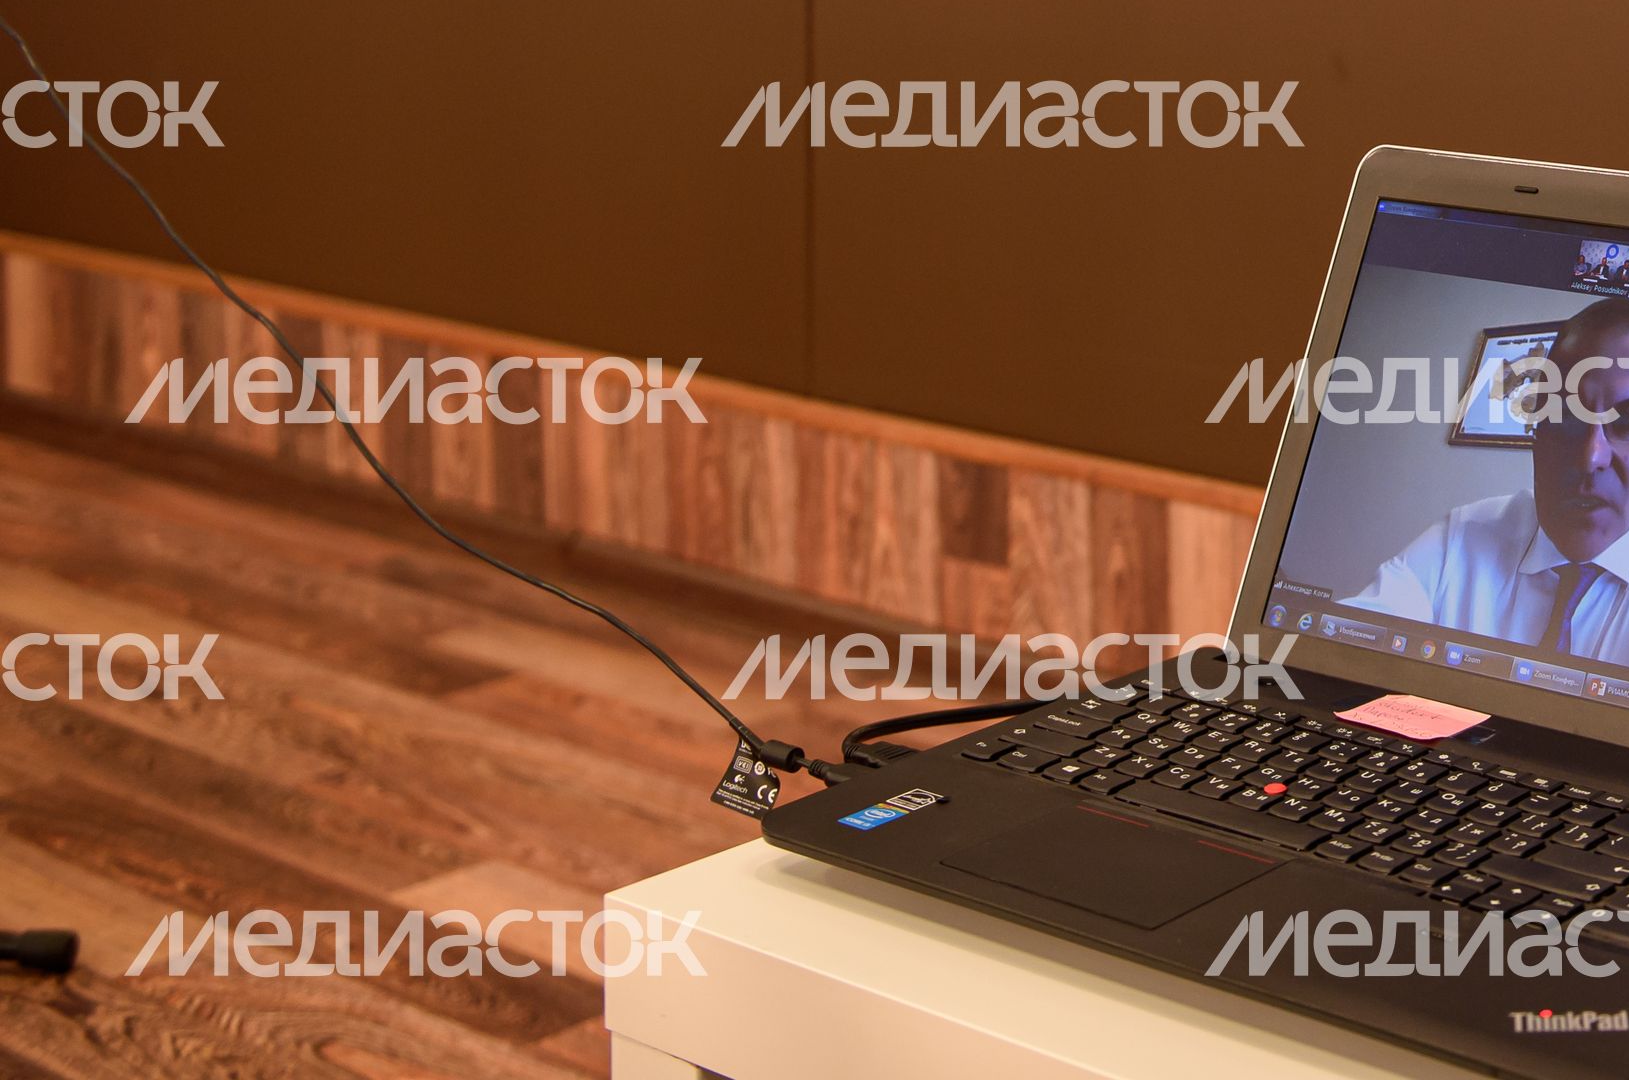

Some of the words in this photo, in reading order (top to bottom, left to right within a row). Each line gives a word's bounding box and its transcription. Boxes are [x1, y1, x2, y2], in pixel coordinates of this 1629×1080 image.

[1463, 655, 1481, 664] Zoom
[1534, 671, 1551, 680] Zoom
[722, 780, 748, 794] Logitech
[1508, 1009, 1629, 1033] ThinkPad
